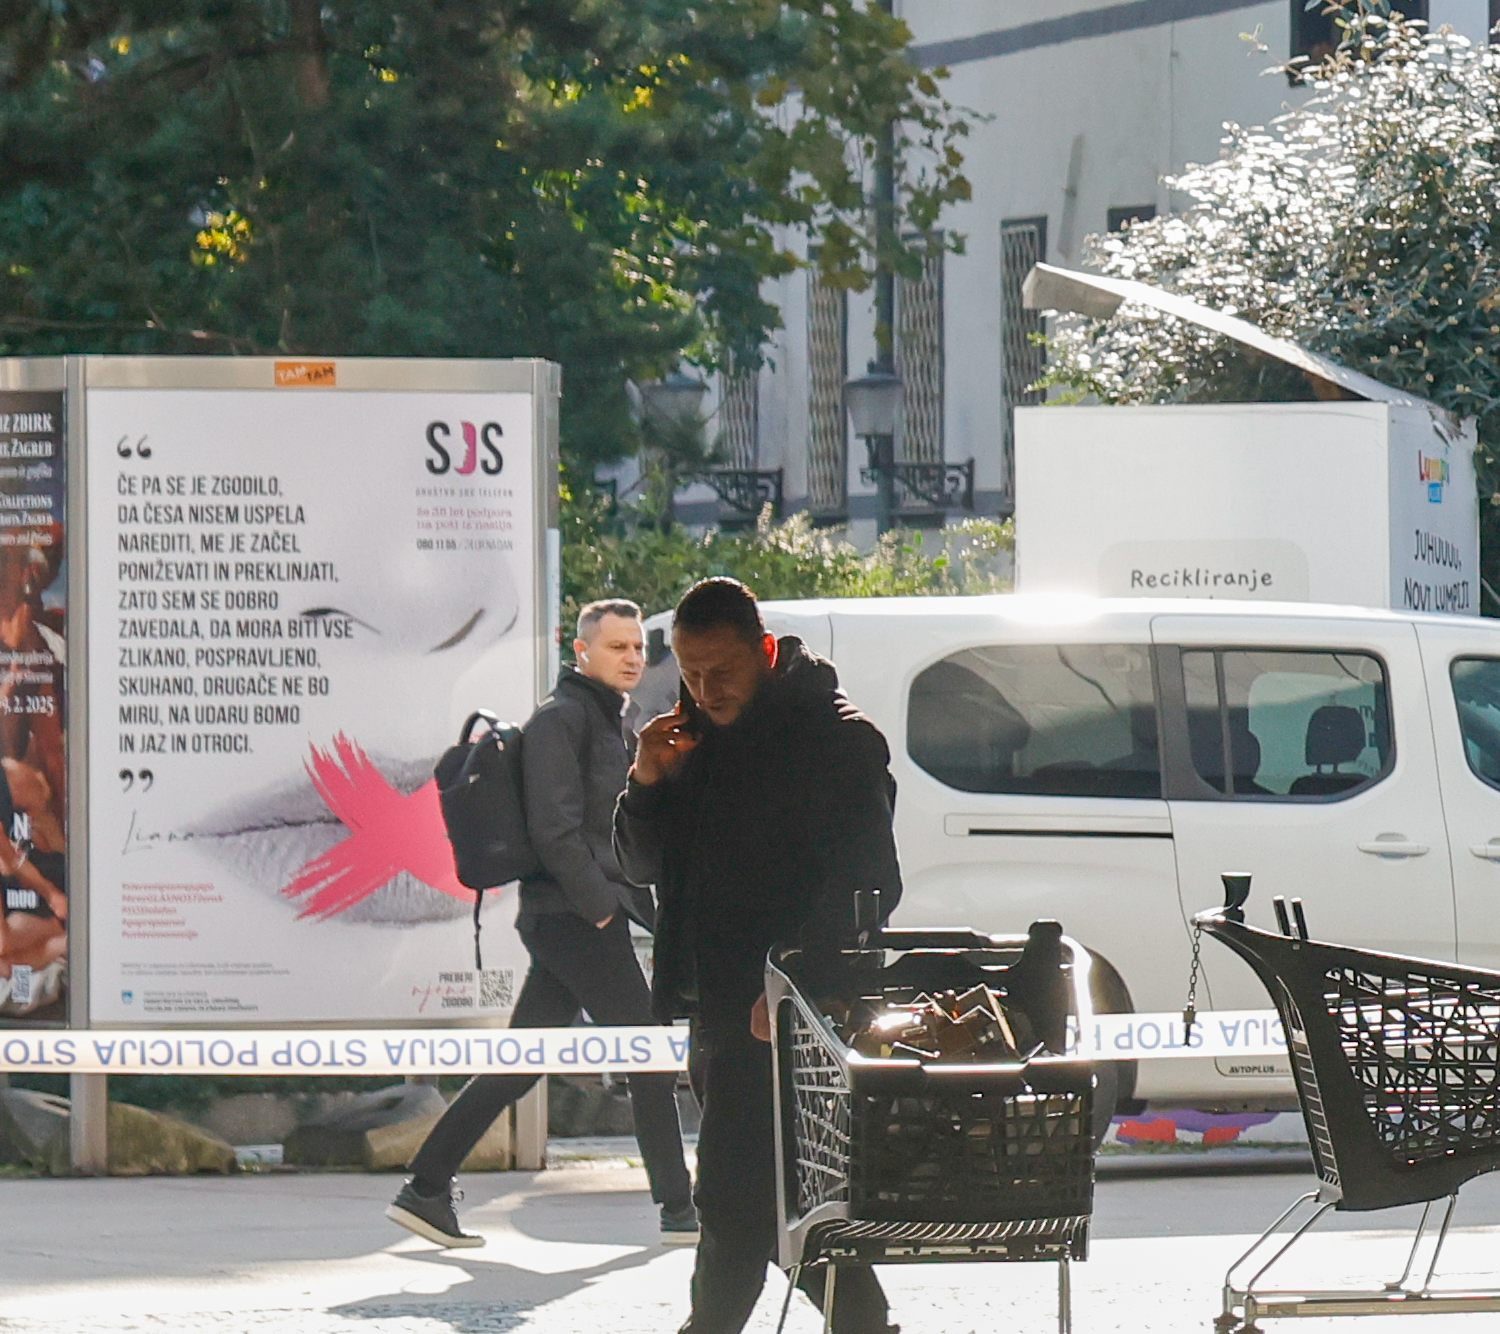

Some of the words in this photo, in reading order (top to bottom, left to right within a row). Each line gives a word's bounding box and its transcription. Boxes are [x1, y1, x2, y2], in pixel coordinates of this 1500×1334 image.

[117, 471, 137, 496] ČE
[142, 476, 161, 496] PA
[166, 476, 186, 496] SE
[190, 476, 207, 496] JE
[211, 476, 283, 498] ZGODILO,
[118, 505, 139, 524] DA
[143, 501, 184, 524] ČESA
[189, 505, 239, 524] NISEM
[244, 505, 305, 524] USPELA
[118, 533, 195, 554] NAREDITI,
[200, 533, 224, 553] ME
[229, 533, 245, 553] JE
[250, 529, 301, 553] ZAČEL
[118, 559, 209, 582] PONIŽEVATI
[214, 563, 229, 582] IN
[234, 563, 339, 583] PREKLINJATI,
[1131, 568, 1273, 592] Recikliranje
[118, 591, 157, 610] ZATO
[162, 591, 195, 610] SEM
[200, 591, 220, 610] SE
[225, 591, 278, 610] DOBRO
[118, 619, 205, 640] ZAVEDALA,
[210, 619, 231, 639] DA
[236, 619, 283, 639] MORA
[288, 619, 318, 639] BITI
[322, 619, 354, 639] VSE
[119, 647, 190, 669] ZLIKANO,
[195, 647, 321, 669] POSPRAVLJENO,
[119, 676, 198, 698] SKUHANO,
[203, 672, 277, 697] DRUGAČE
[282, 676, 302, 697] NE
[308, 676, 329, 697] BO
[25, 694, 54, 717] 2025
[119, 705, 164, 726] MIRU,
[168, 705, 190, 725] NA
[195, 705, 248, 725] UDARU
[253, 705, 300, 725] BOMO
[119, 734, 135, 754] IN
[139, 734, 166, 754] JAZ
[171, 734, 186, 754] IN
[191, 734, 253, 754] OTROCI.
[3, 1039, 77, 1065] STO
[93, 1040, 258, 1066] POLICIJA
[271, 1039, 368, 1066] STOP
[383, 1038, 545, 1066] POLICIJA
[558, 1036, 652, 1065] STOP
[1230, 1065, 1274, 1074] AVTOPLUS
